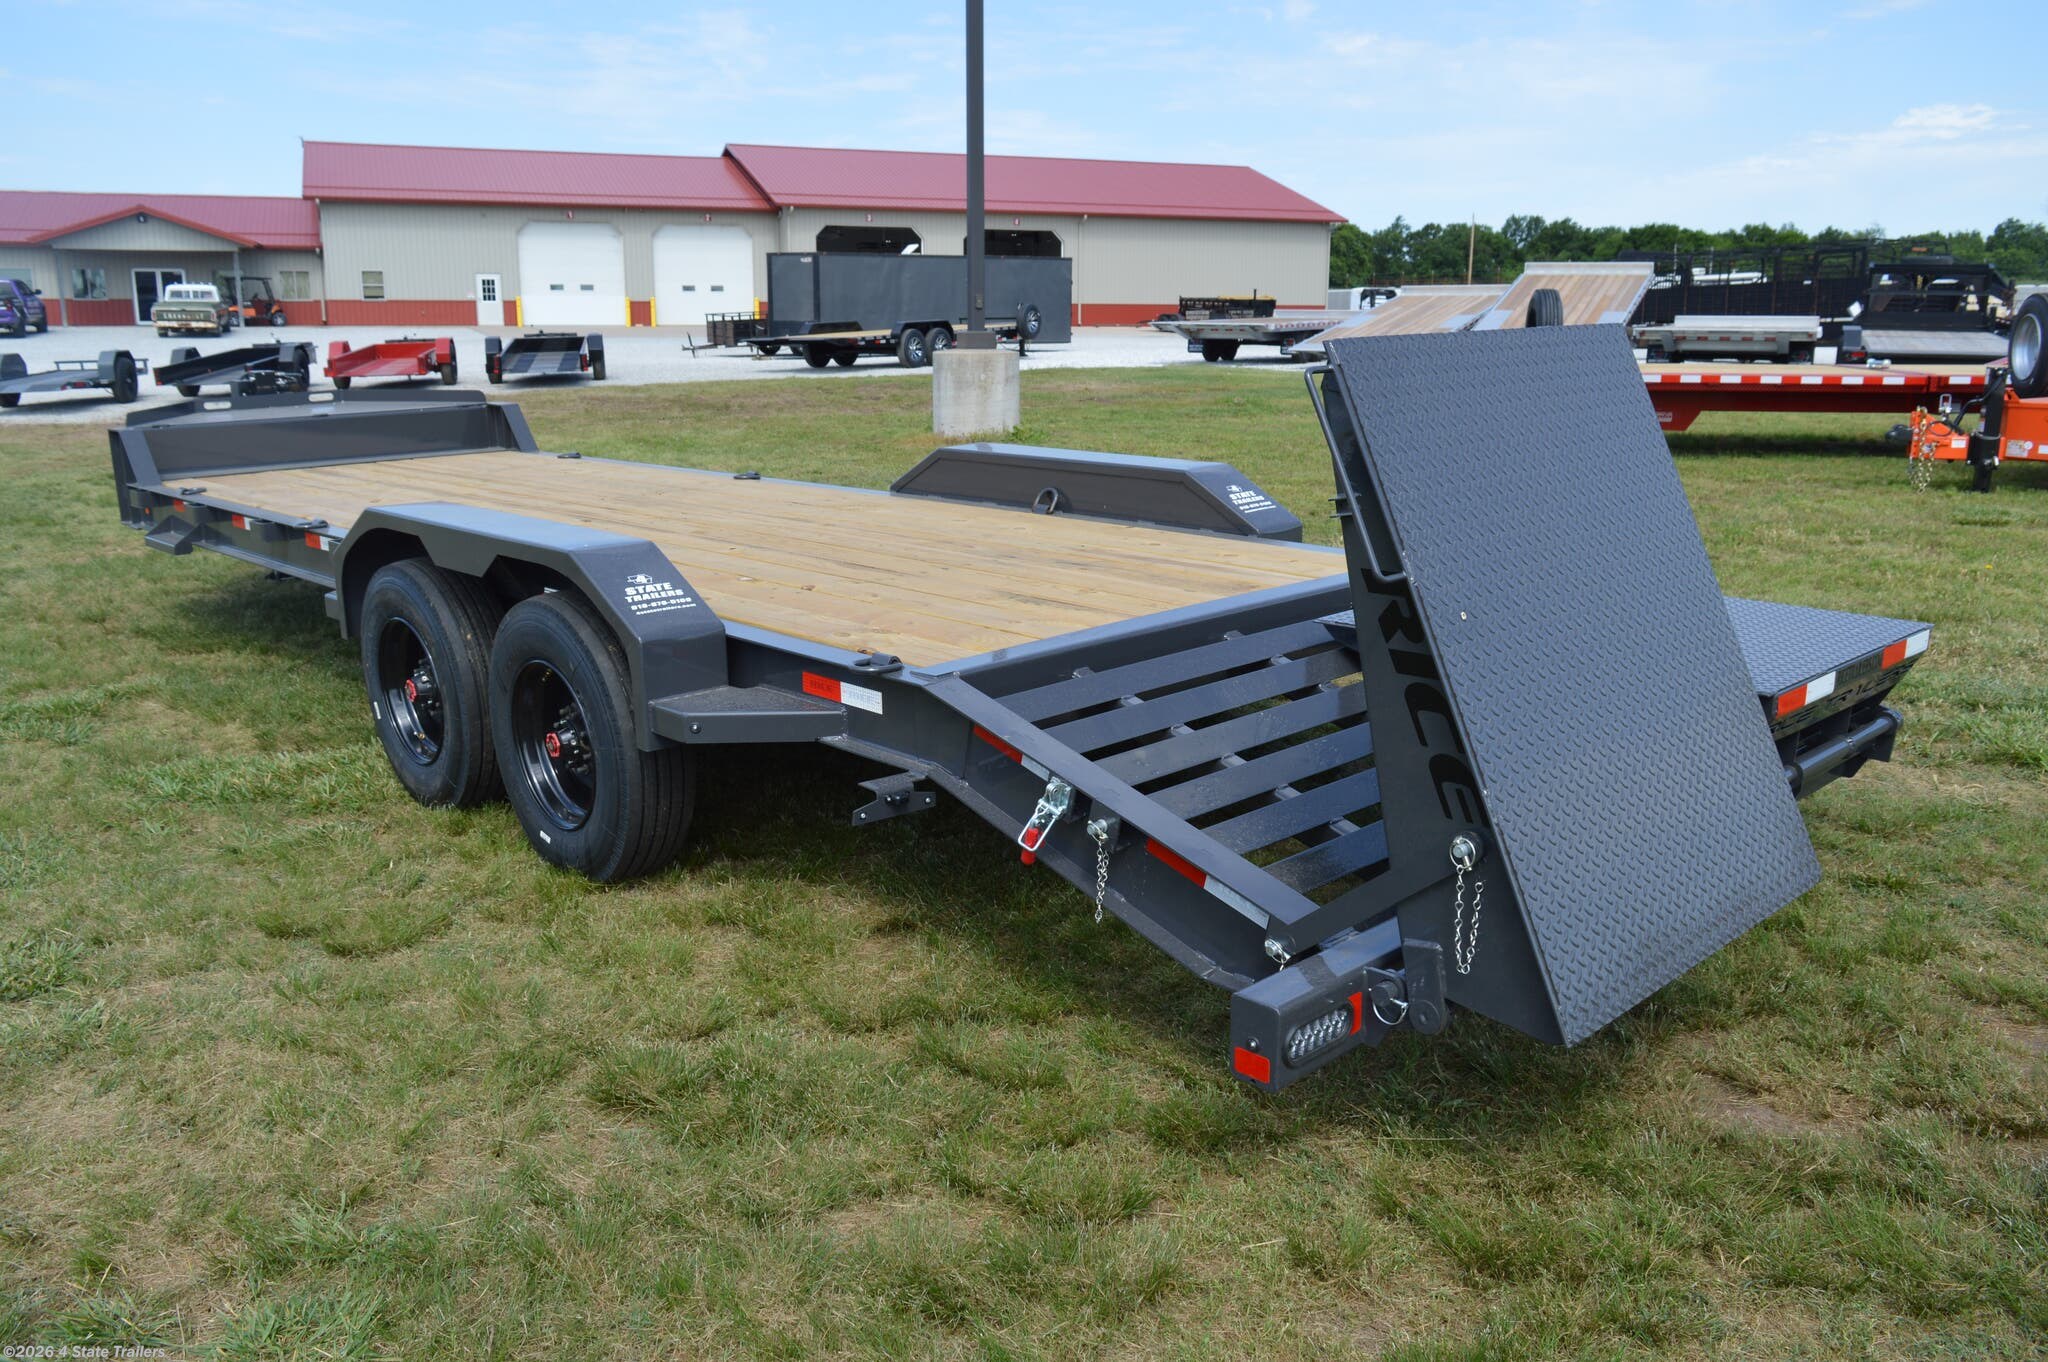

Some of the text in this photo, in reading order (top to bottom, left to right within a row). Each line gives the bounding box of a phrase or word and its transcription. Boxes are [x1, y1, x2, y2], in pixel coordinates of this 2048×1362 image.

[625, 582, 673, 595] STATE
[625, 588, 684, 603] TRAILERS
[1361, 568, 1492, 830] RICE
